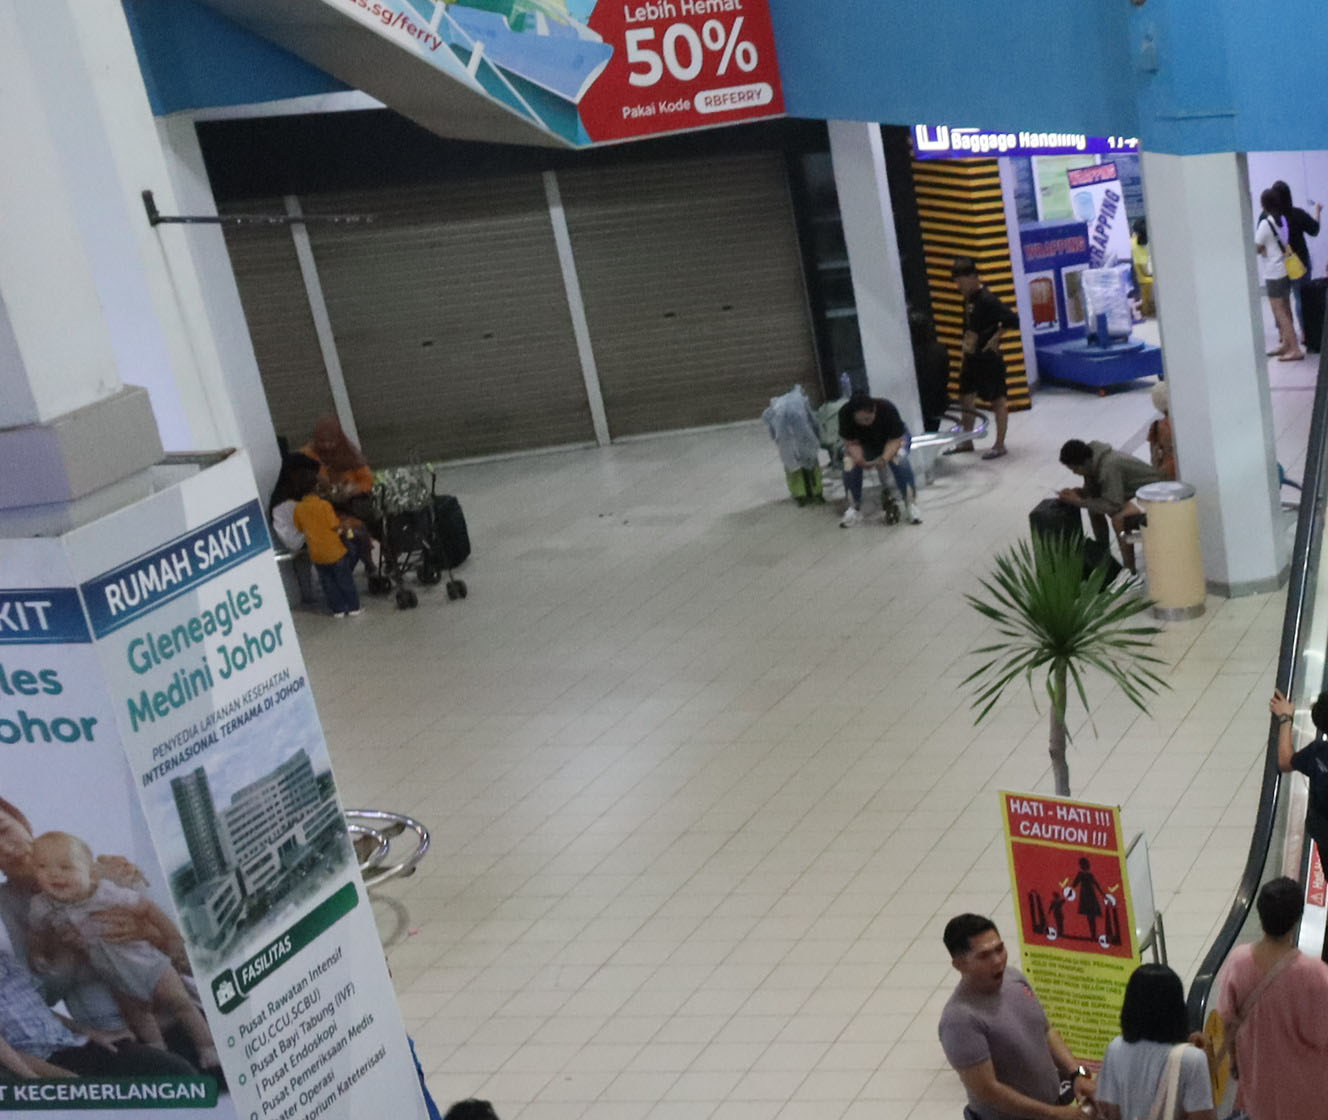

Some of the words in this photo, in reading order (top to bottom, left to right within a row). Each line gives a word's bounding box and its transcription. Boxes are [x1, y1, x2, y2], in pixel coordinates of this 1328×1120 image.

[350, 0, 442, 51] s.sg/ferry
[624, 1, 675, 22] Lebih
[680, 0, 742, 19] Hemat
[624, 16, 758, 87] 50%
[622, 102, 656, 120] Pakai
[659, 97, 691, 115] Kode
[704, 88, 763, 108] RBFERRY
[951, 132, 1017, 153] Baggage
[104, 548, 193, 616] RUMAH
[193, 516, 251, 570] SAKIT
[126, 583, 263, 675] Gleneagles
[126, 655, 214, 733] Medini
[216, 621, 284, 680] Johor
[142, 733, 220, 787] INTERNASIONAL
[220, 704, 263, 738] TERNAMA
[265, 697, 272, 711] DI
[275, 676, 306, 704] JOHOR
[1010, 799, 1044, 817] HATI
[1056, 806, 1091, 824] HATI
[1095, 811, 1111, 826] !!!
[1020, 820, 1089, 843] CAUTION
[1092, 831, 1108, 846] !!!
[241, 935, 293, 985] FASILITAS
[239, 1013, 268, 1038] Pusat
[267, 978, 308, 1016] Rawatan
[309, 946, 343, 982] Intensif
[251, 1050, 279, 1077] Pusat
[279, 1033, 300, 1055] Bayi
[299, 1002, 335, 1033] Tabung
[334, 982, 356, 1010] (IVF)
[262, 1064, 289, 1092] Pusat
[290, 1023, 339, 1068] Endoskopi
[262, 1089, 290, 1116] Pusat
[289, 1039, 348, 1091] Pemeriksaan
[348, 1013, 375, 1041] Medis
[337, 1046, 387, 1098] Kateterisasi
[14, 1083, 206, 1101] KECEMERLANGAN
[299, 1071, 336, 1106] Operasi
